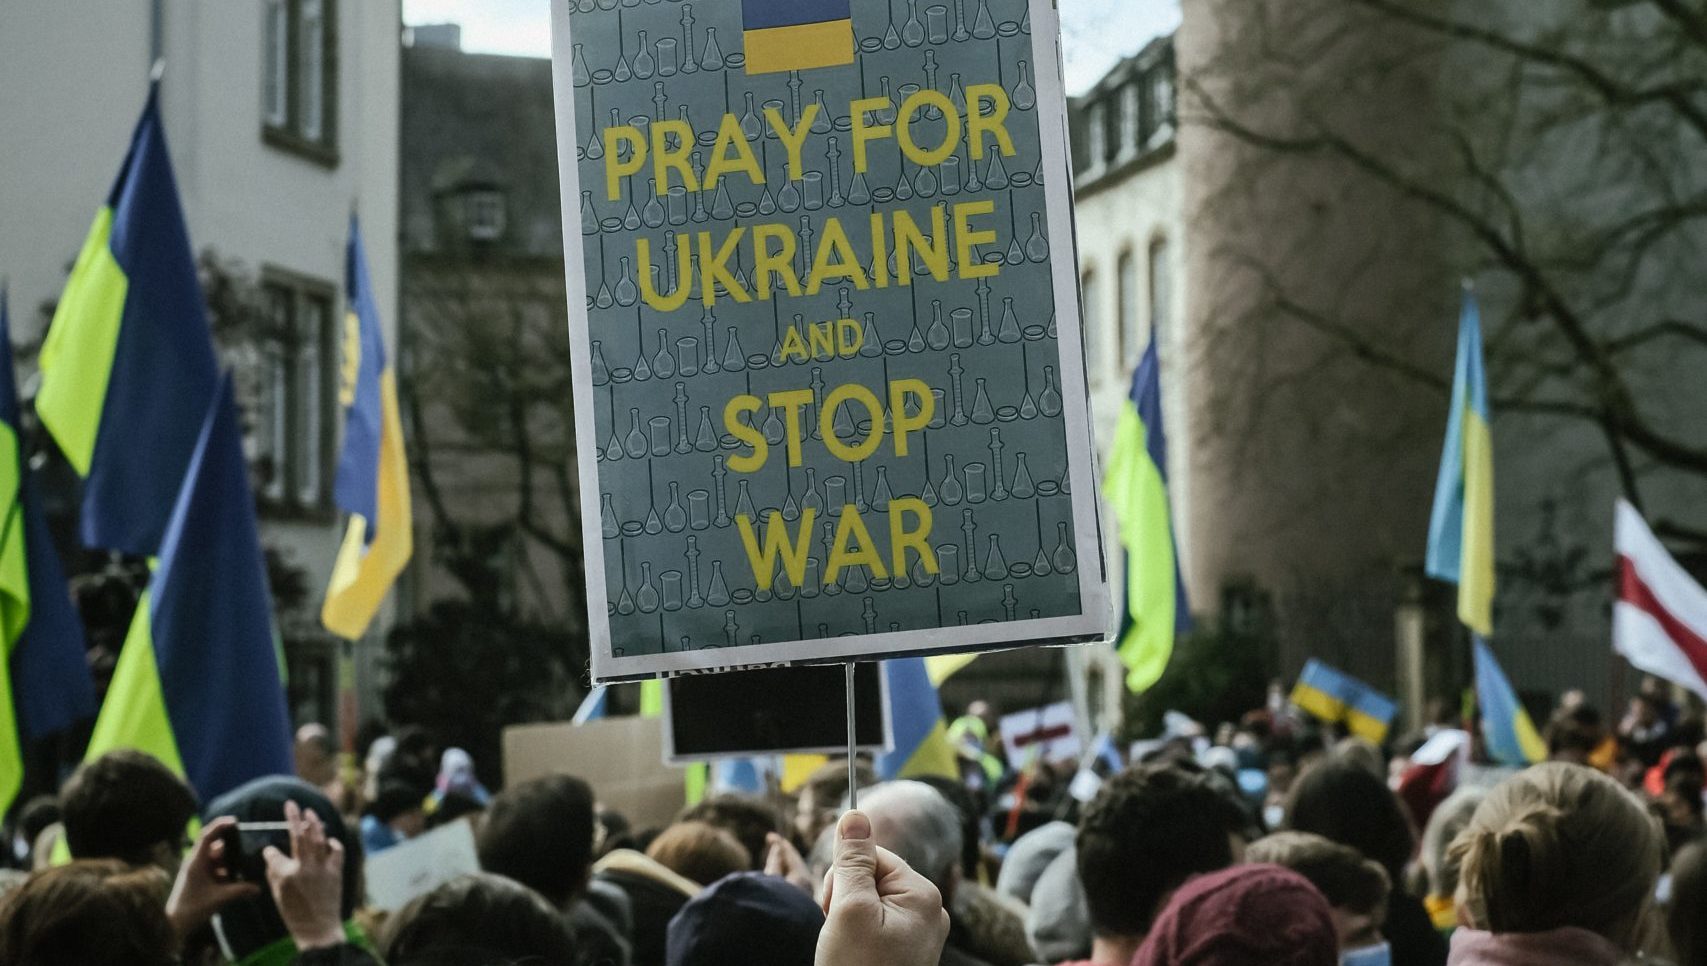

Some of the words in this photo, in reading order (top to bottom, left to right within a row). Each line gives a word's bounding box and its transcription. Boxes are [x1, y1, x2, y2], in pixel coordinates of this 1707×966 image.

[604, 105, 818, 199] PRAY
[850, 84, 1016, 174] FOR
[637, 201, 1000, 312] UKRAINE
[780, 319, 863, 362] AND
[723, 379, 935, 473] STOP
[736, 498, 939, 591] WAR
